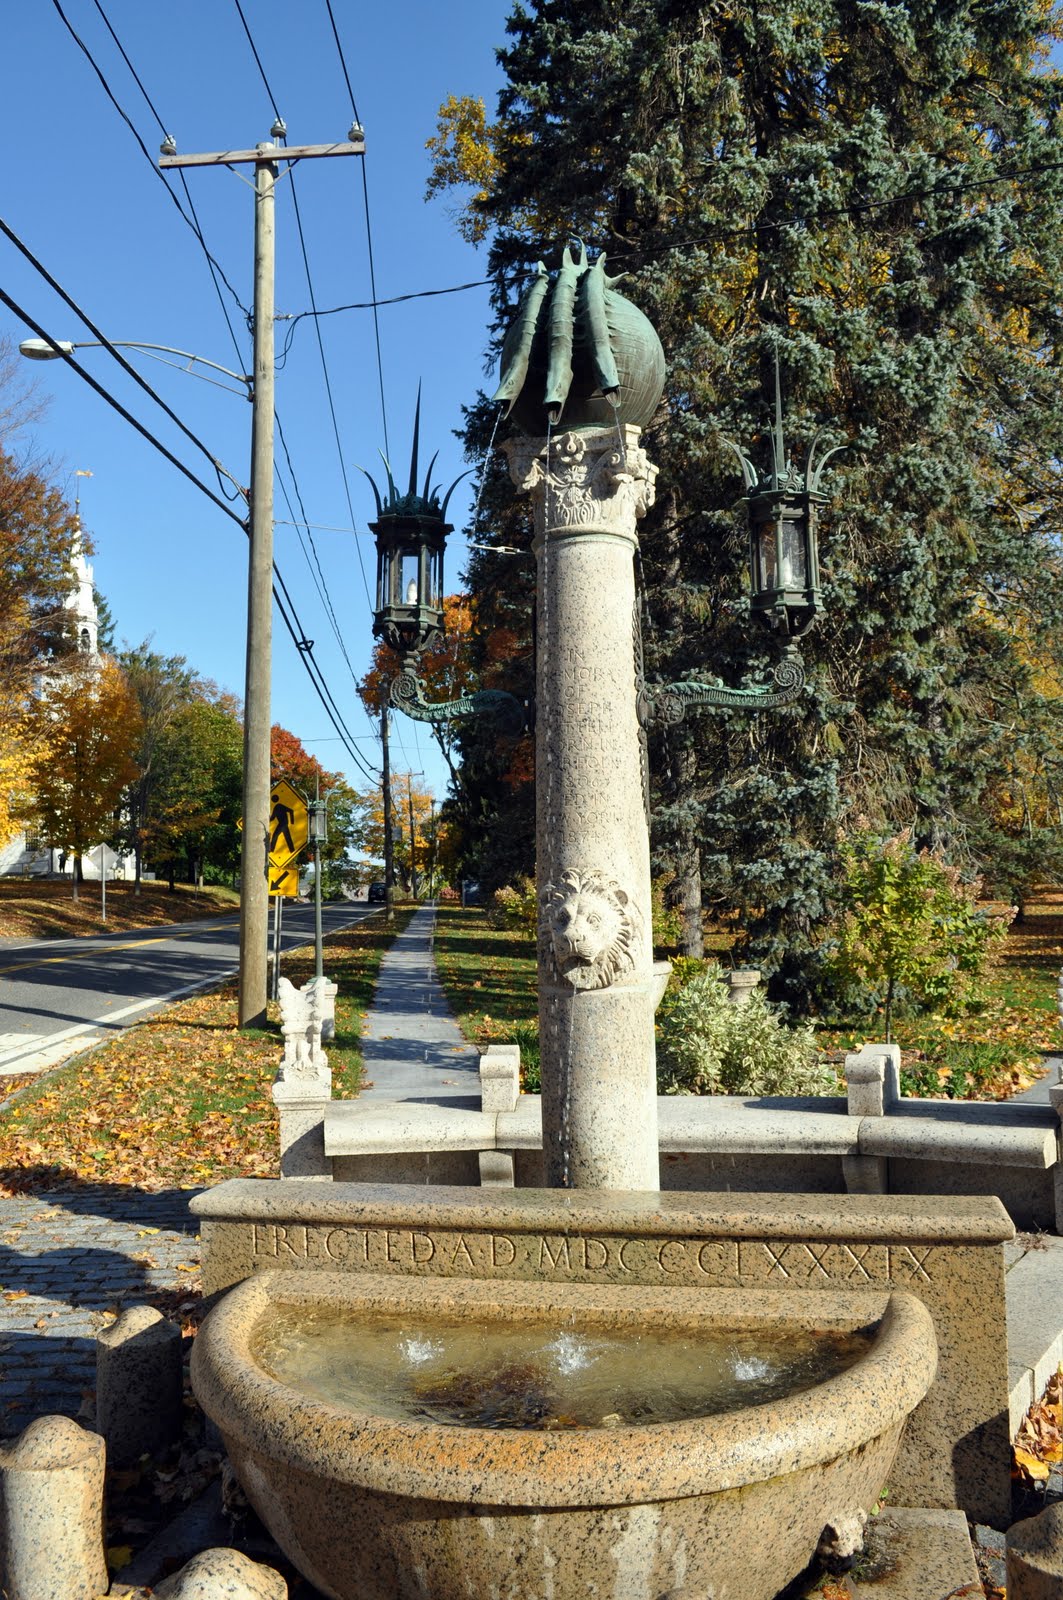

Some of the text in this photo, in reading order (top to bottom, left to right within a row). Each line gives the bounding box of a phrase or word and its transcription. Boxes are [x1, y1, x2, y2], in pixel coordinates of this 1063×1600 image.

[563, 685, 586, 699] OF
[251, 1224, 436, 1264] ERECTED
[539, 1236, 935, 1282] MDCCCLXXXIX
